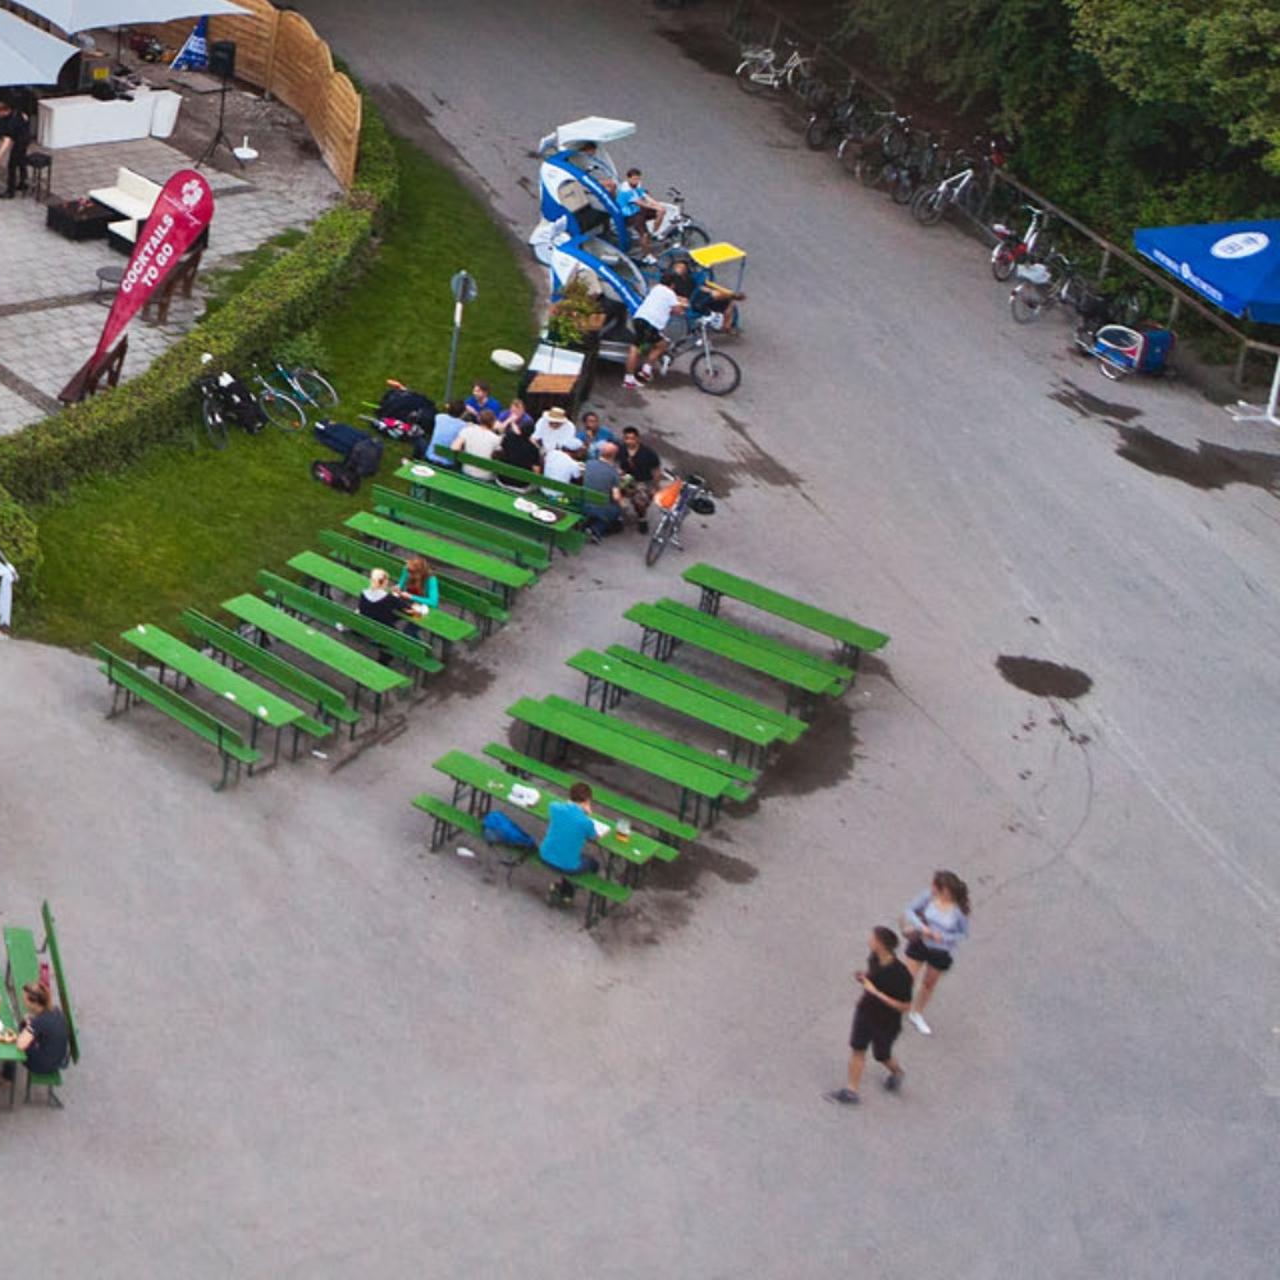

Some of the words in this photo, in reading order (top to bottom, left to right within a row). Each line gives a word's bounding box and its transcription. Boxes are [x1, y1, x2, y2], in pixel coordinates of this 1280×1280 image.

[121, 214, 175, 293] COCKTAILS
[141, 266, 159, 287] TO
[155, 243, 174, 267] GO
